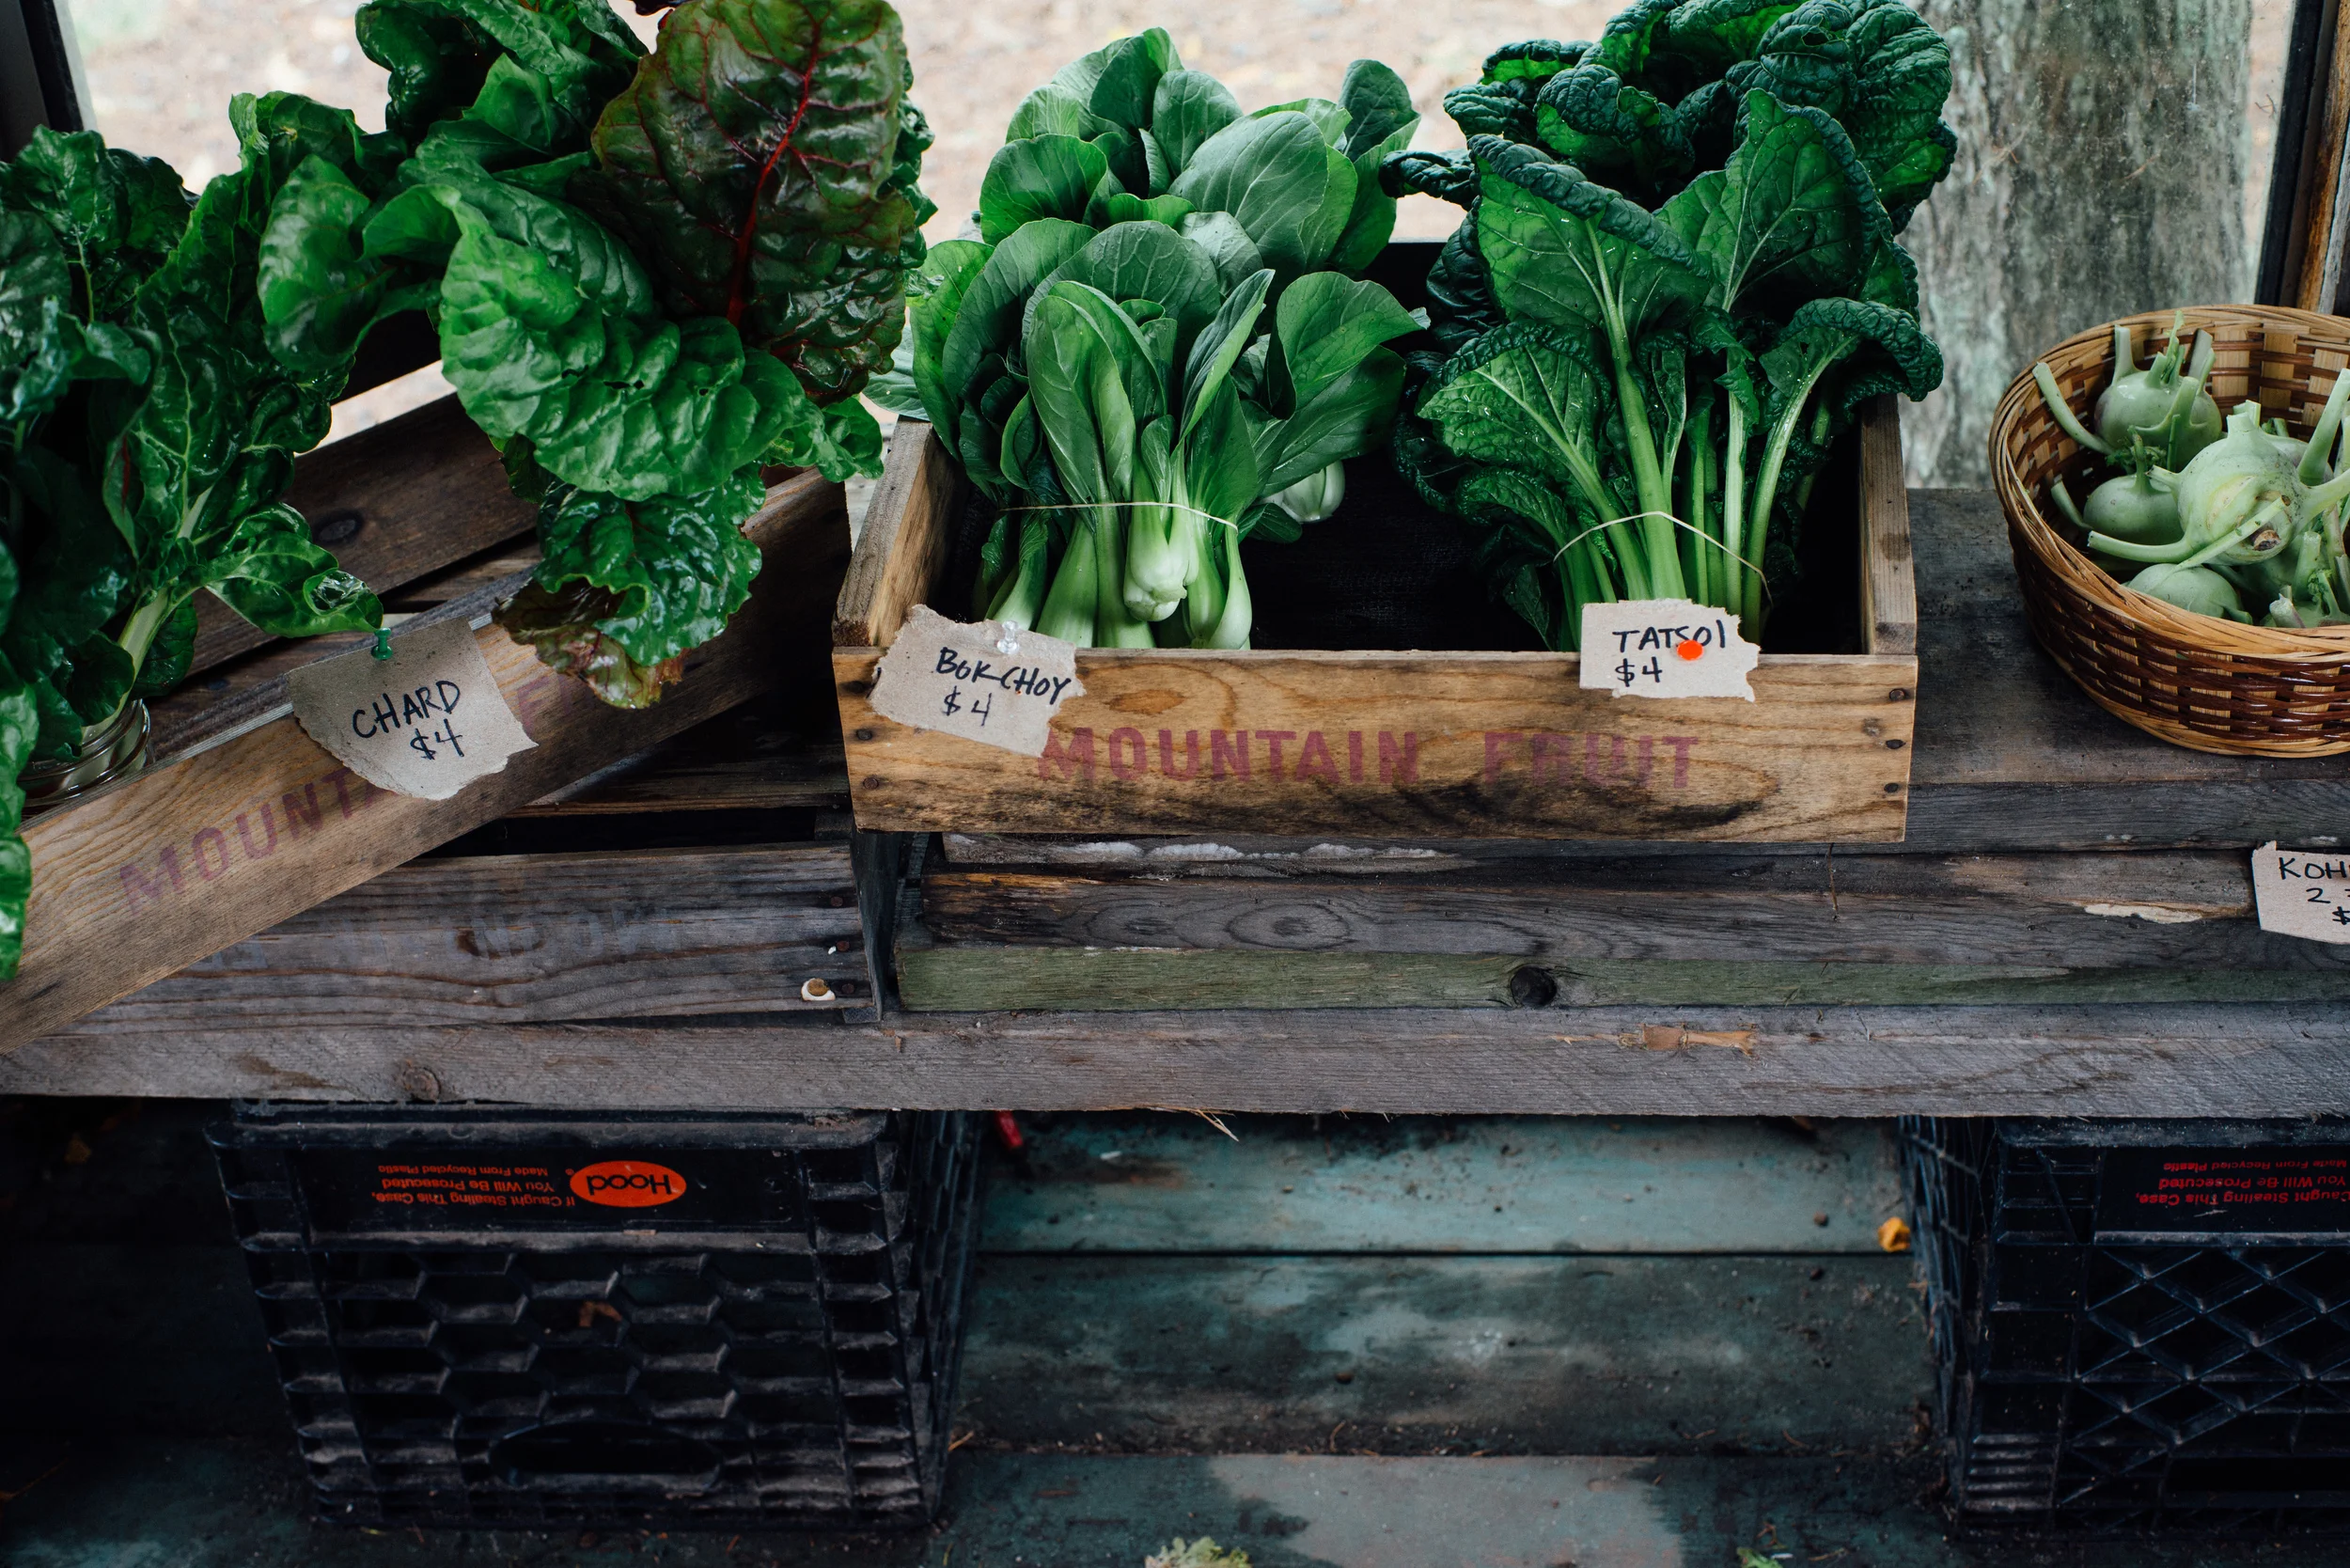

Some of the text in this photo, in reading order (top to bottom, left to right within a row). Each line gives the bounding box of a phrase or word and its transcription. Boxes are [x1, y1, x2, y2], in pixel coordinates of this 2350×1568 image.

[936, 646, 1072, 706] BOK CHOY
[1615, 656, 1663, 687] $4
[352, 681, 461, 739] CHARD
[943, 684, 992, 727] $4
[410, 718, 465, 760] $4
[1038, 727, 1700, 789] MOUNTAIN FRUIT
[378, 1165, 548, 1177] Made From Recycled Plastic
[2163, 1159, 2347, 1173] Made From Recycled Plastic
[382, 1179, 555, 1193] You Will Be Prosecuted
[586, 1174, 672, 1196] Hood
[2158, 1175, 2347, 1190] You Will Be Prosecuted
[416, 1193, 448, 1205] This
[449, 1192, 508, 1207] Stealing
[510, 1194, 563, 1207] Caught
[566, 1196, 575, 1207] If
[2136, 1192, 2181, 1206] Case,
[2185, 1192, 2219, 1205] This
[2223, 1190, 2290, 1203] Stealing
